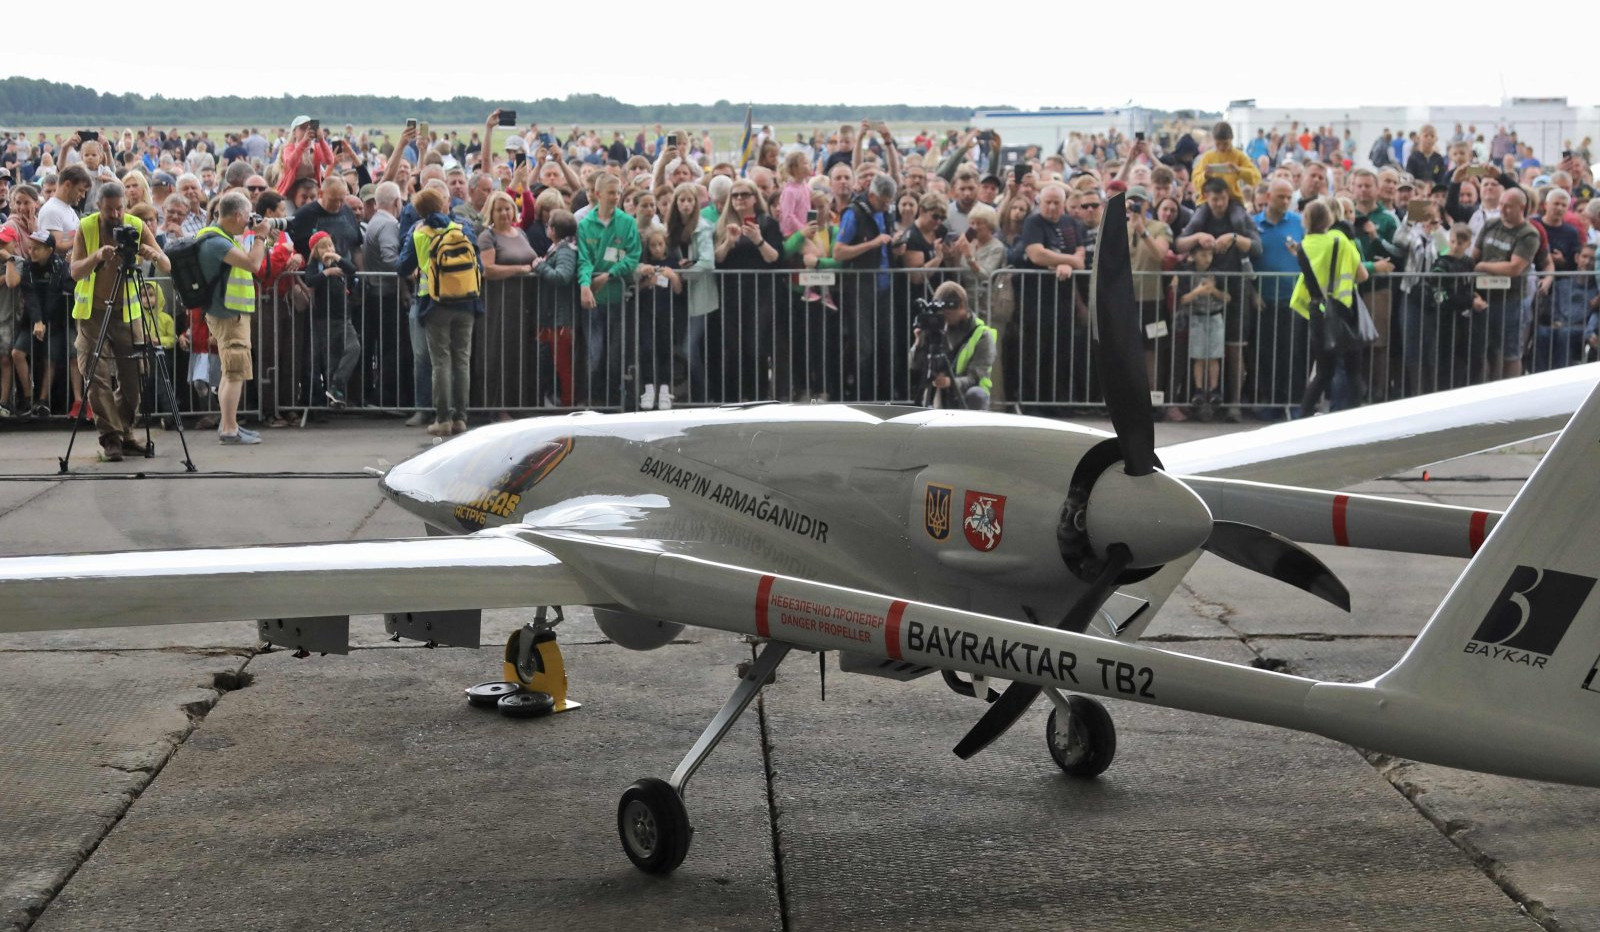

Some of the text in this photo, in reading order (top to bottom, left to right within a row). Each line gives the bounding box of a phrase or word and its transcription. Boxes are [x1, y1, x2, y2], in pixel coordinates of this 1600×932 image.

[709, 483, 830, 544] ARMAĞANIDIR
[770, 594, 884, 629] НЕБЕЗПЕЧНО ПРОПЕЛЕР
[780, 613, 872, 644] DANGER PROPELLER
[907, 620, 1156, 699] BAYRAKTAR TB2
[1463, 641, 1548, 670] BAYKAR
